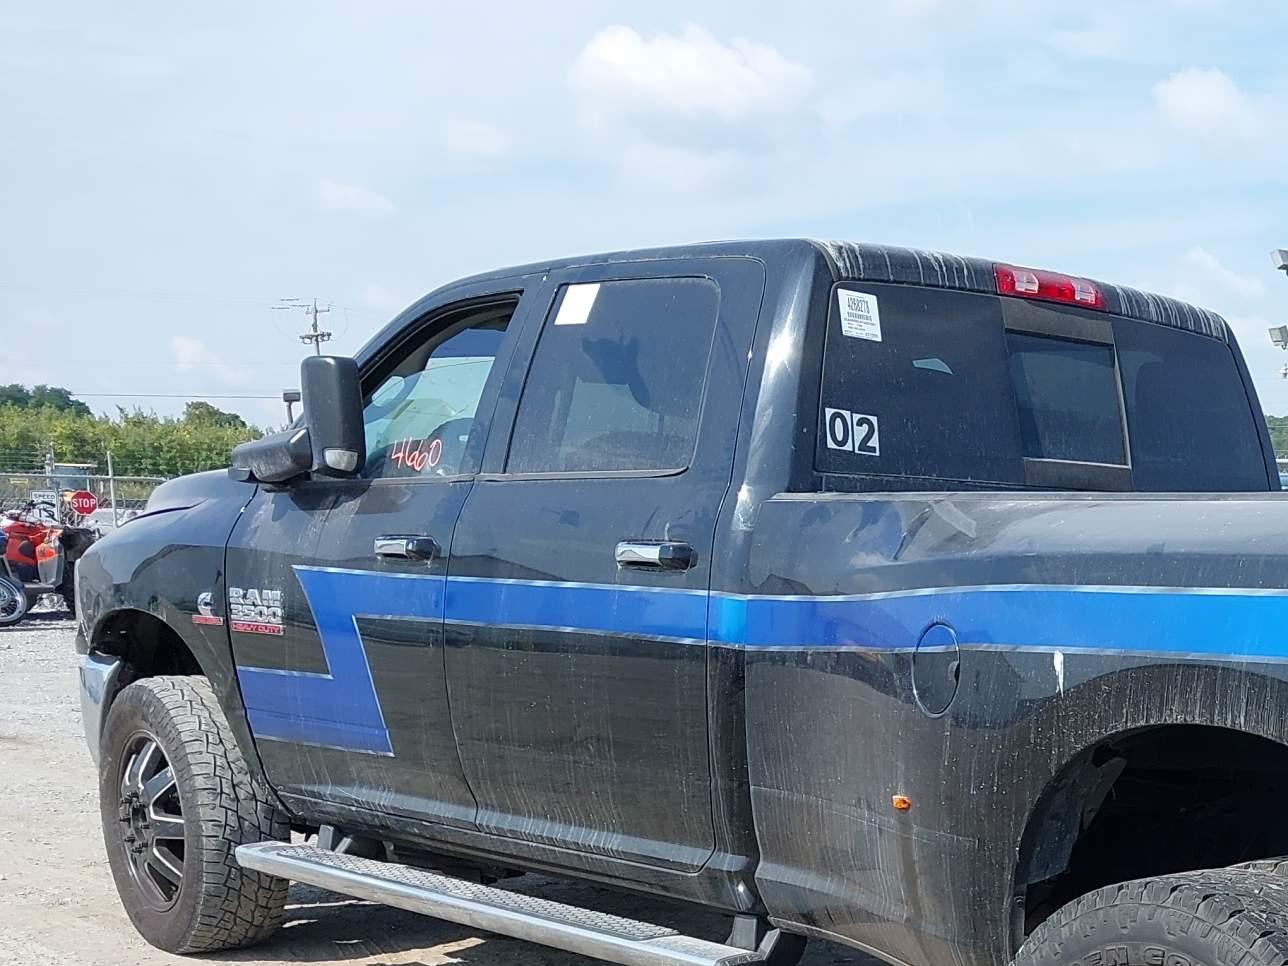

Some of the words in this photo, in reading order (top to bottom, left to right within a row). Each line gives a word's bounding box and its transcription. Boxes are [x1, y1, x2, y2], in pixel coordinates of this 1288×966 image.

[828, 411, 877, 454] 02
[391, 437, 442, 471] 4660
[72, 498, 96, 508] STOP
[229, 588, 281, 606] RAM
[230, 604, 282, 623] 3500
